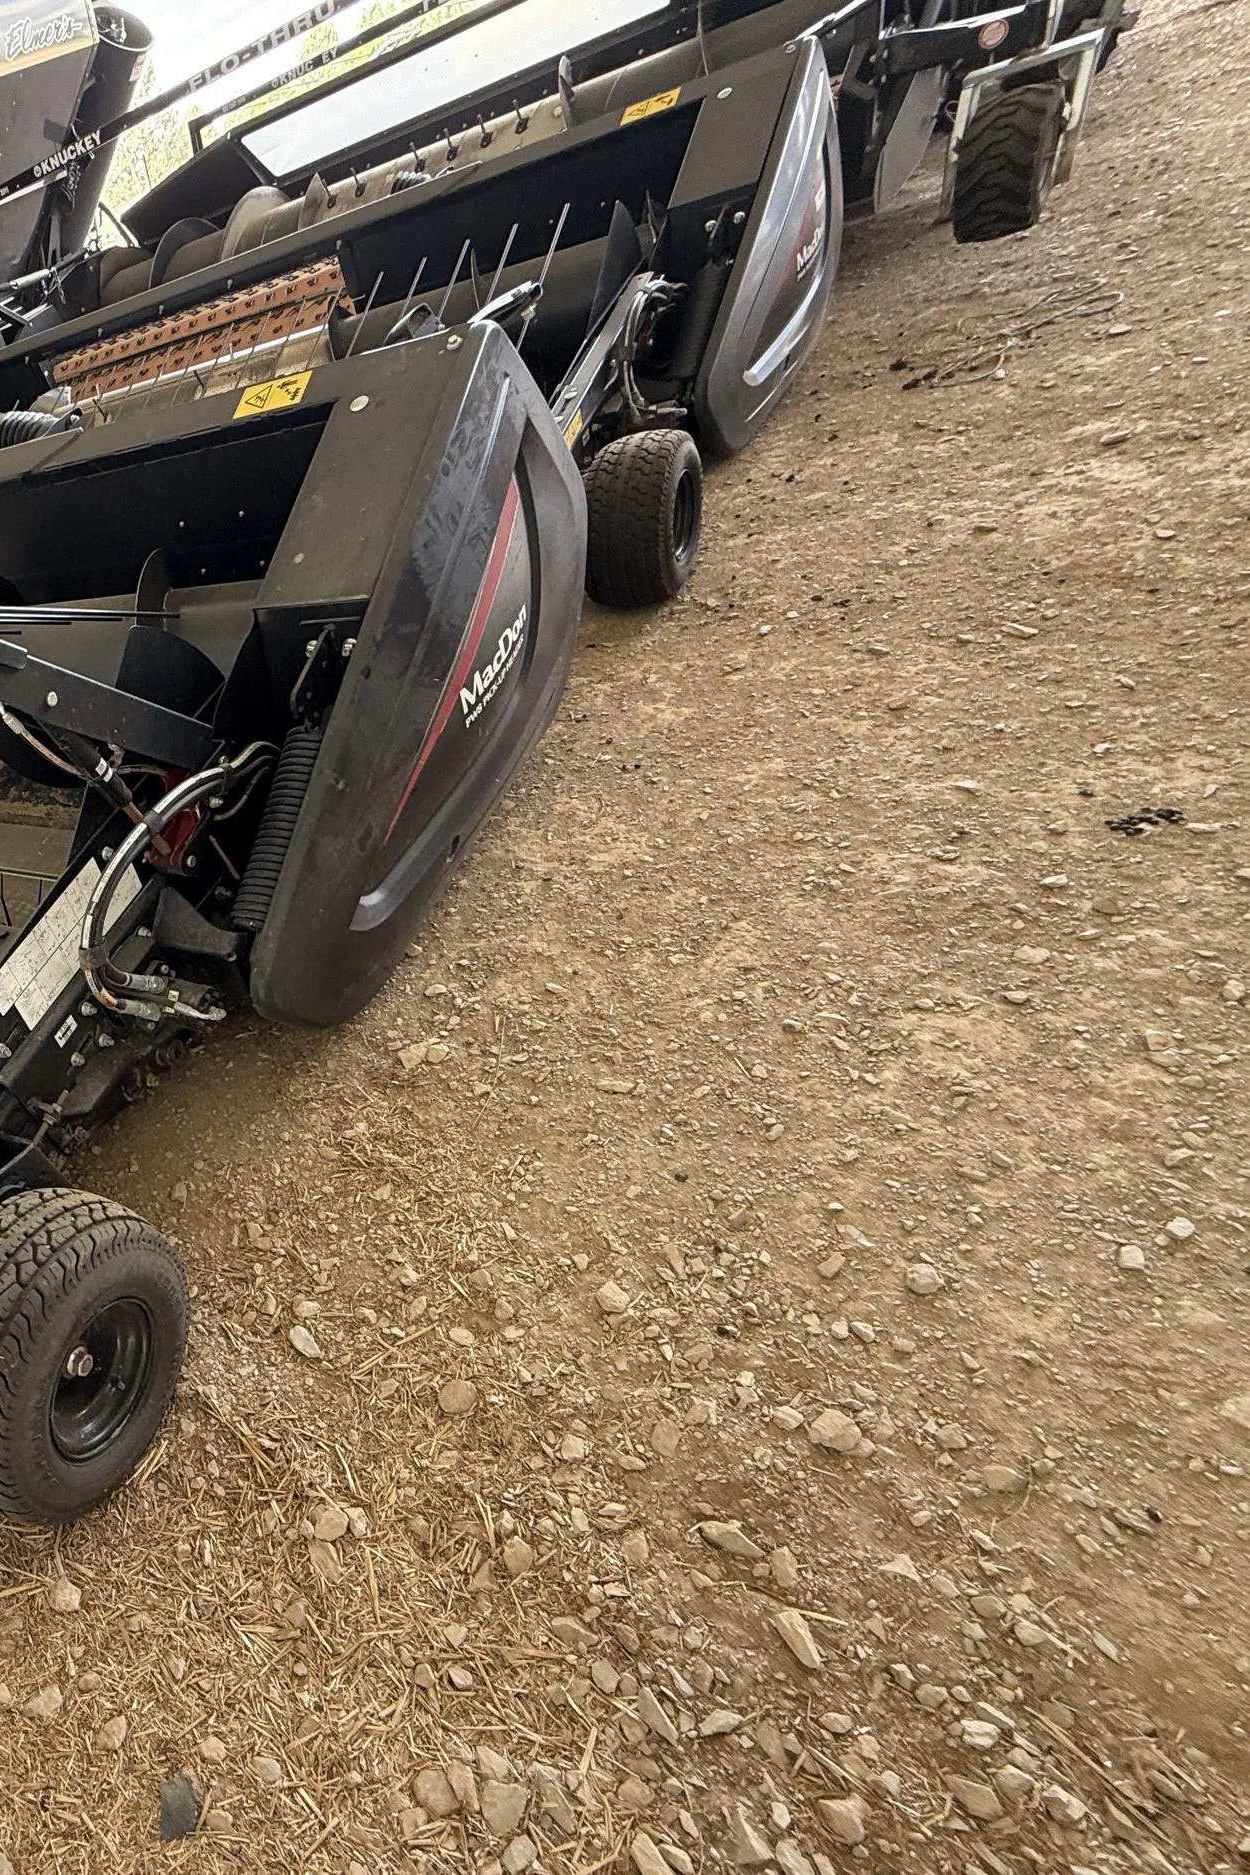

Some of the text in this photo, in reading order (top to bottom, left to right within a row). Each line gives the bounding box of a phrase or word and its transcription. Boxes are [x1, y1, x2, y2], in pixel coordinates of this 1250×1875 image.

[4, 14, 83, 61] Elmer's
[188, 0, 337, 94] FLO-THRU
[40, 129, 101, 175] KNUCKEY
[459, 602, 527, 715] MacDon
